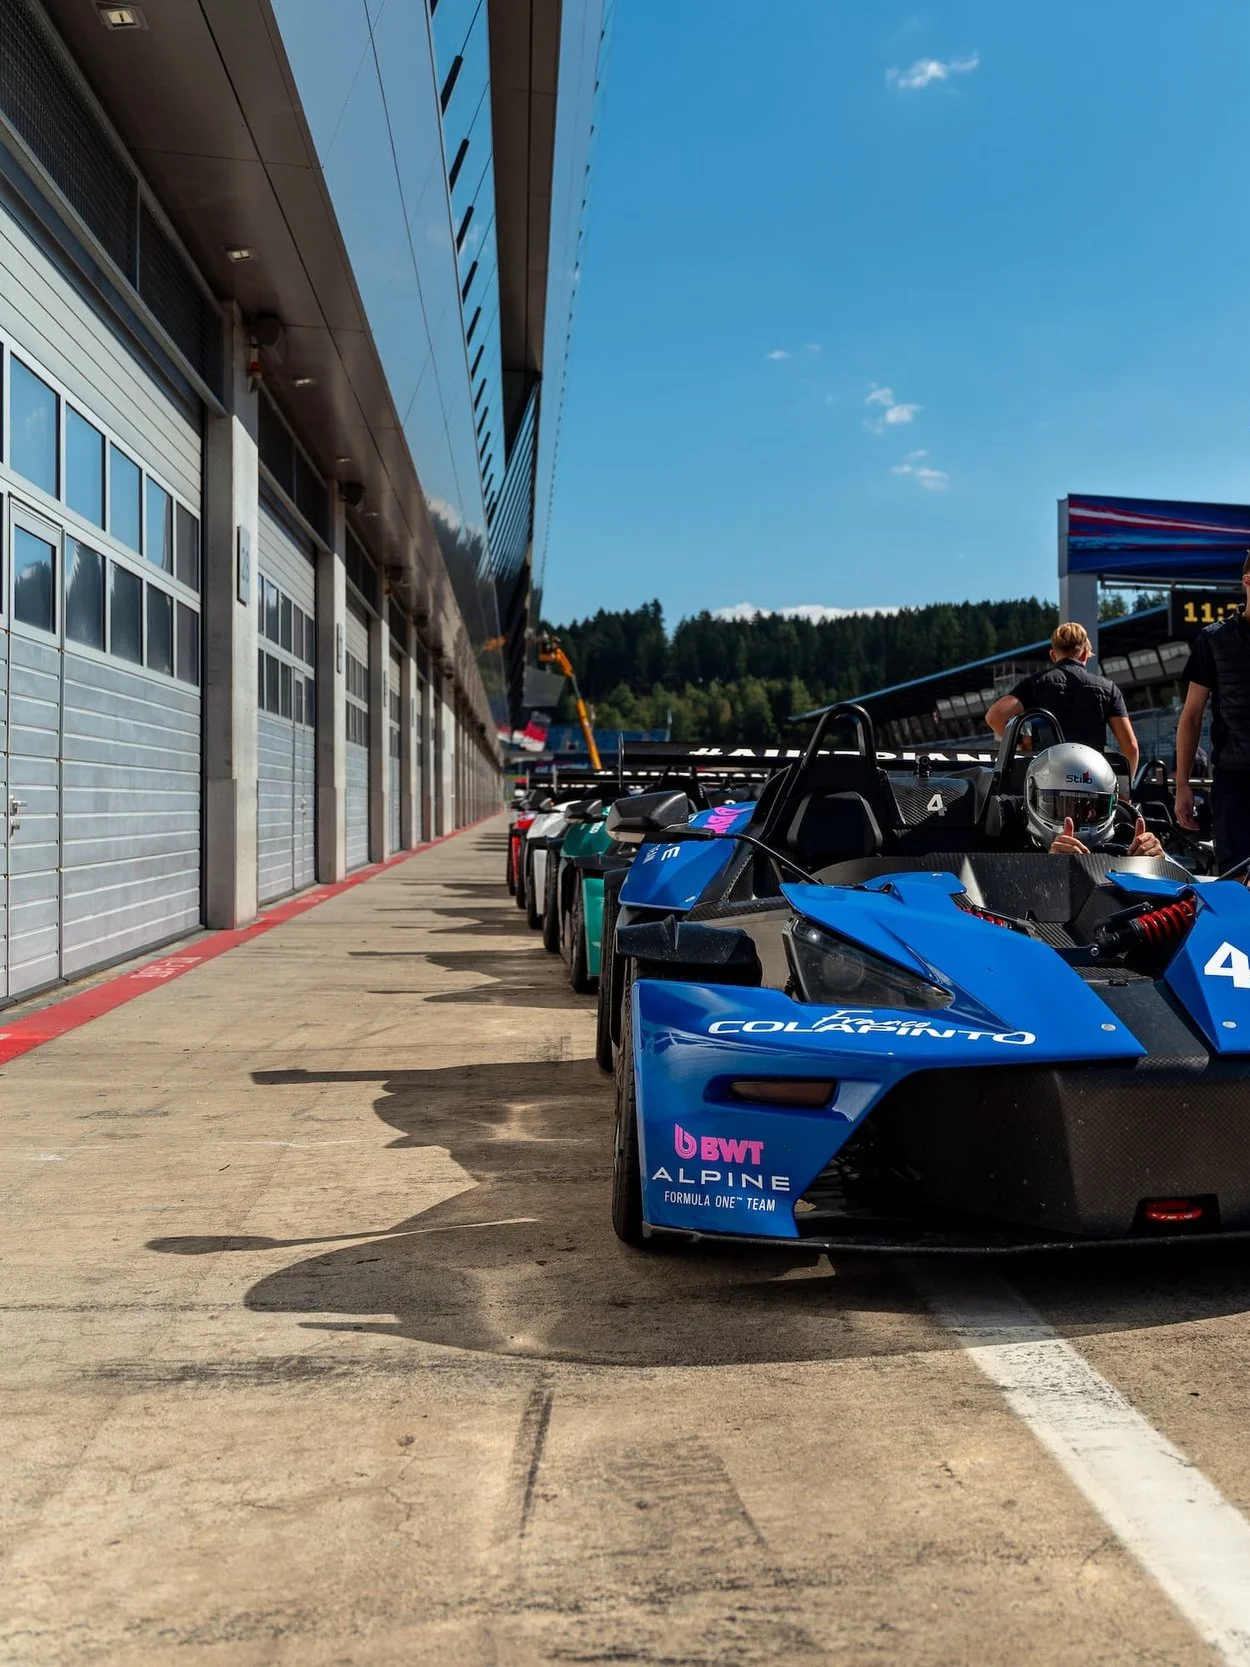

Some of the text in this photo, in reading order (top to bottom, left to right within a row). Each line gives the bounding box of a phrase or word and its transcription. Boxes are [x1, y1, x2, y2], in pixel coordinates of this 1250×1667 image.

[1066, 772, 1093, 785] Stilo
[811, 1009, 931, 1029] Franco
[708, 1020, 1037, 1045] COLAPINTO
[701, 1136, 765, 1165] BWT
[651, 1166, 791, 1192] ALPINE
[664, 1190, 711, 1207] FORMULA
[747, 1197, 776, 1212] TEAM
